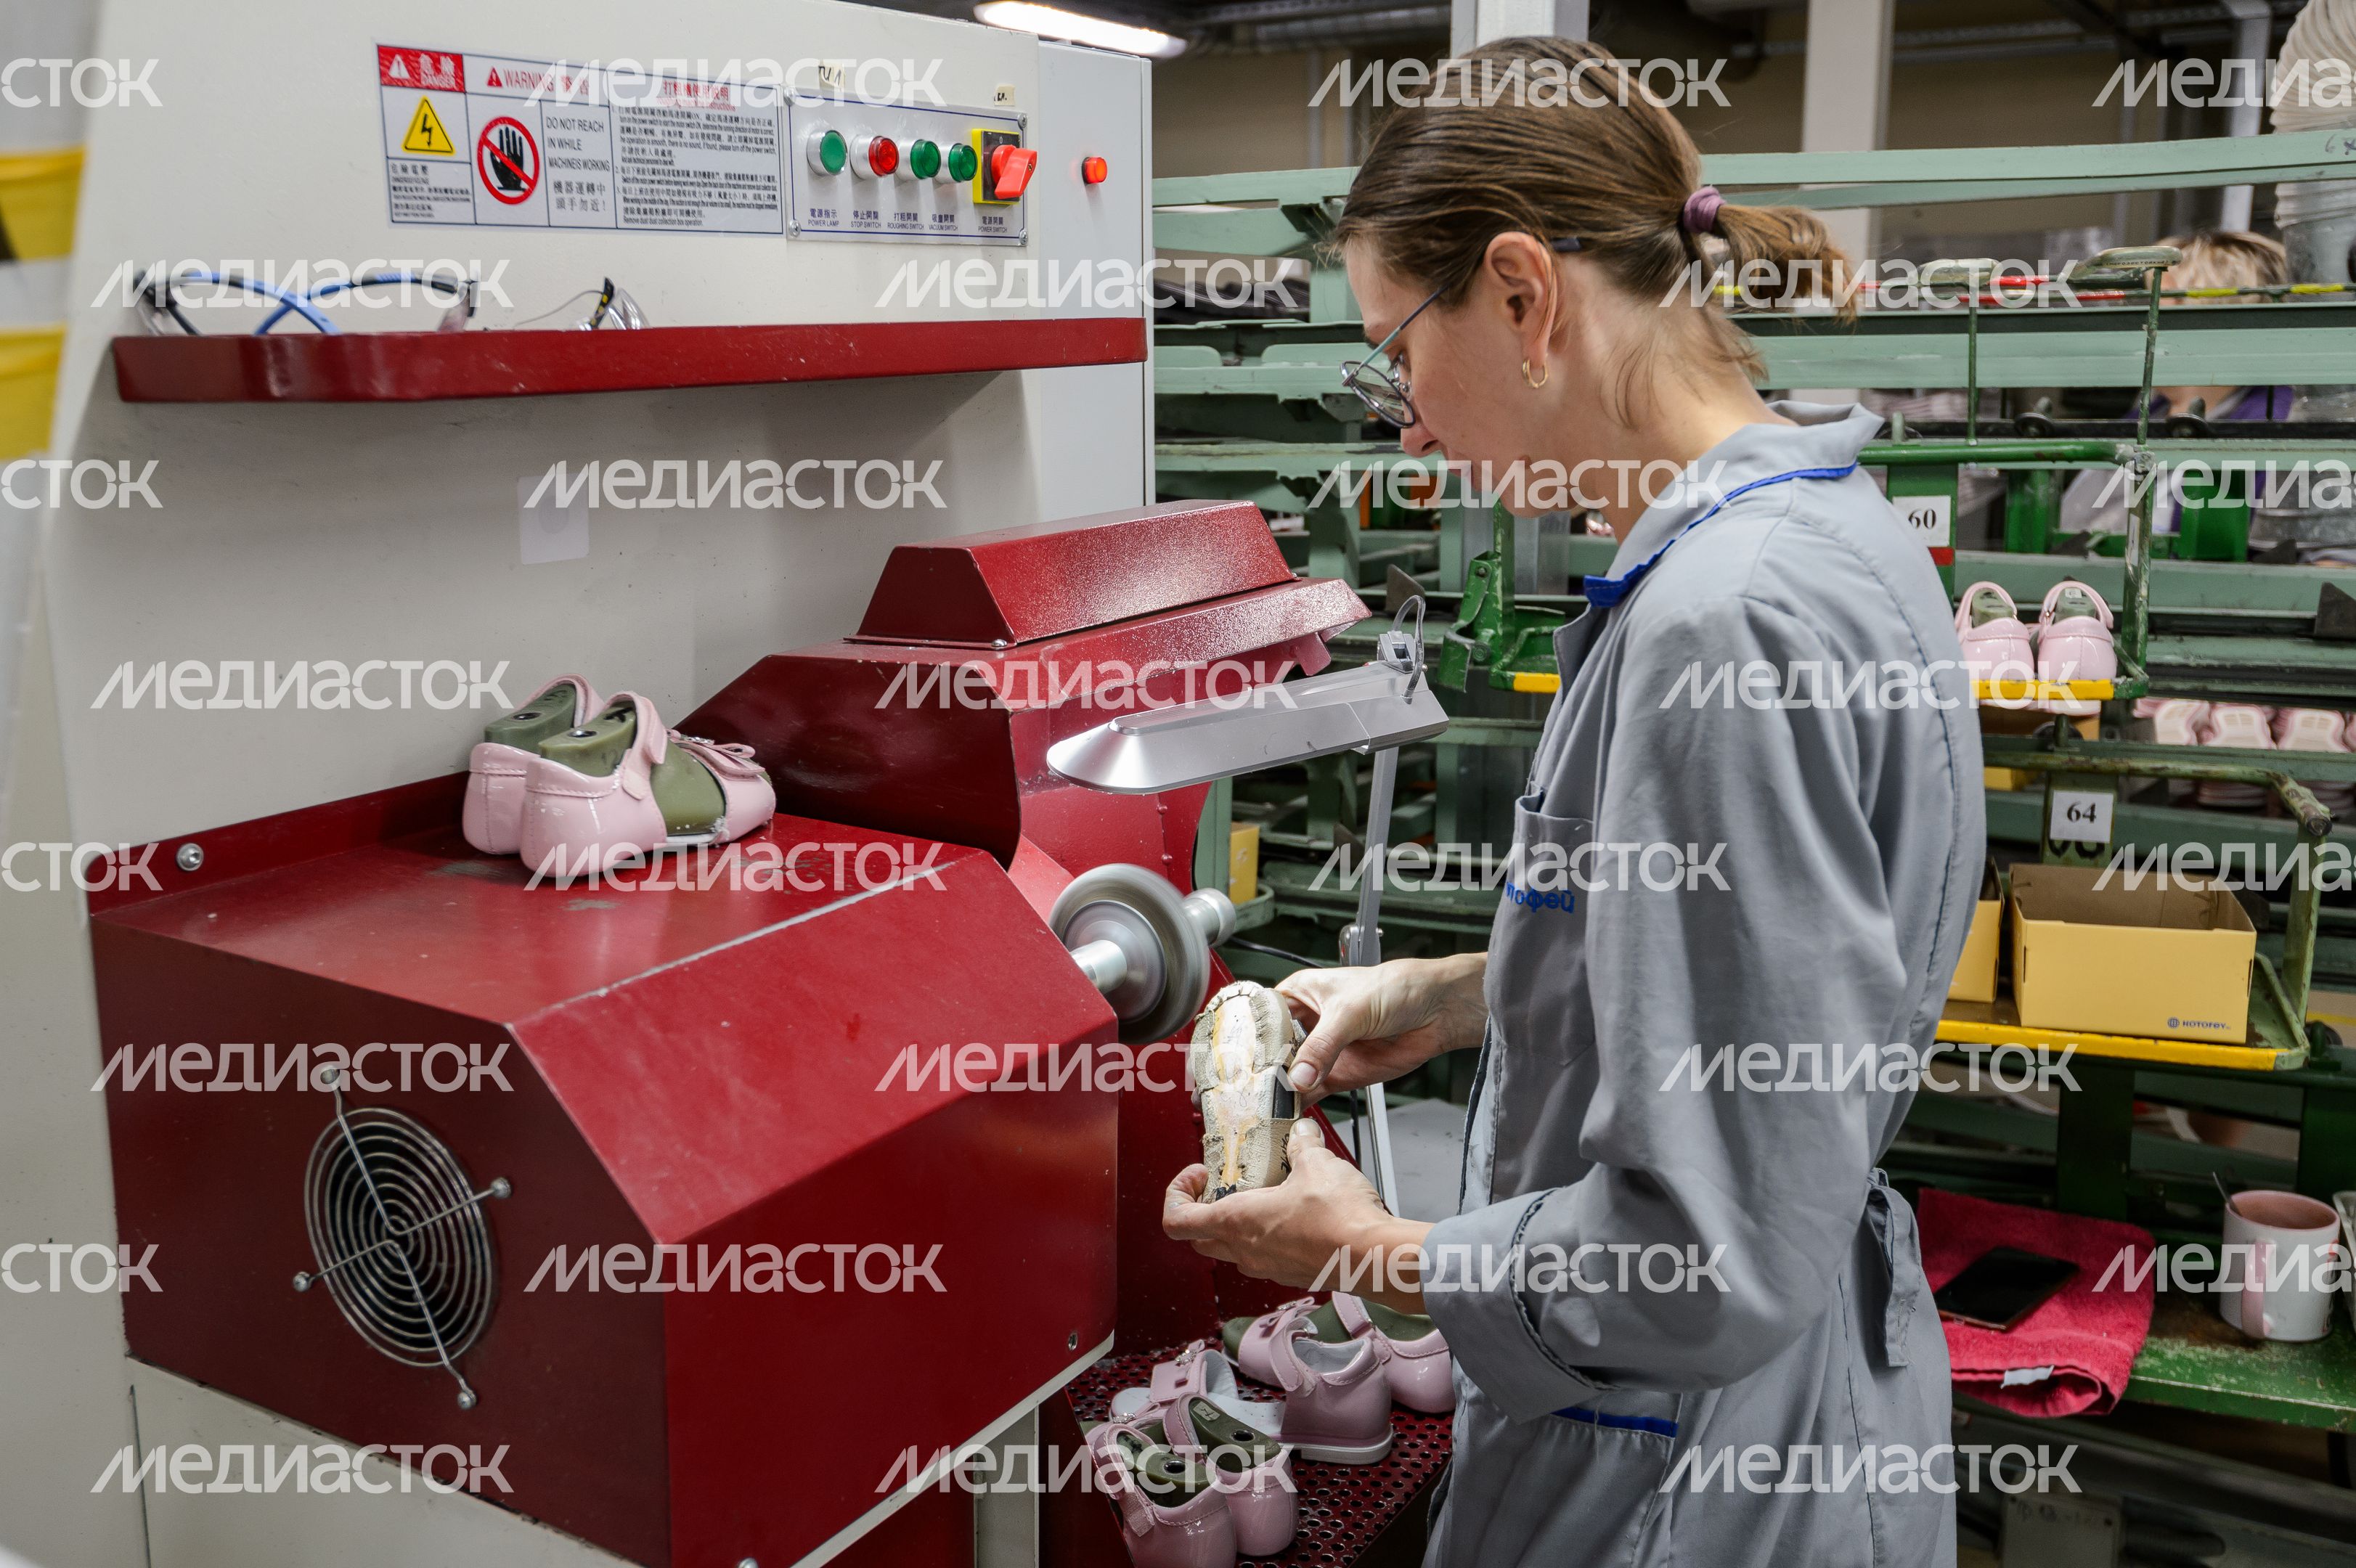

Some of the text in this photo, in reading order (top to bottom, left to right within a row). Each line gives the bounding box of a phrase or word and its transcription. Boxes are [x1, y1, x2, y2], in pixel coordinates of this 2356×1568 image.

[503, 69, 555, 93] WARNING
[547, 116, 605, 134] DO NOT REACH
[557, 136, 582, 152] WHILE
[1908, 507, 1937, 530] 60
[2066, 801, 2097, 824] 64
